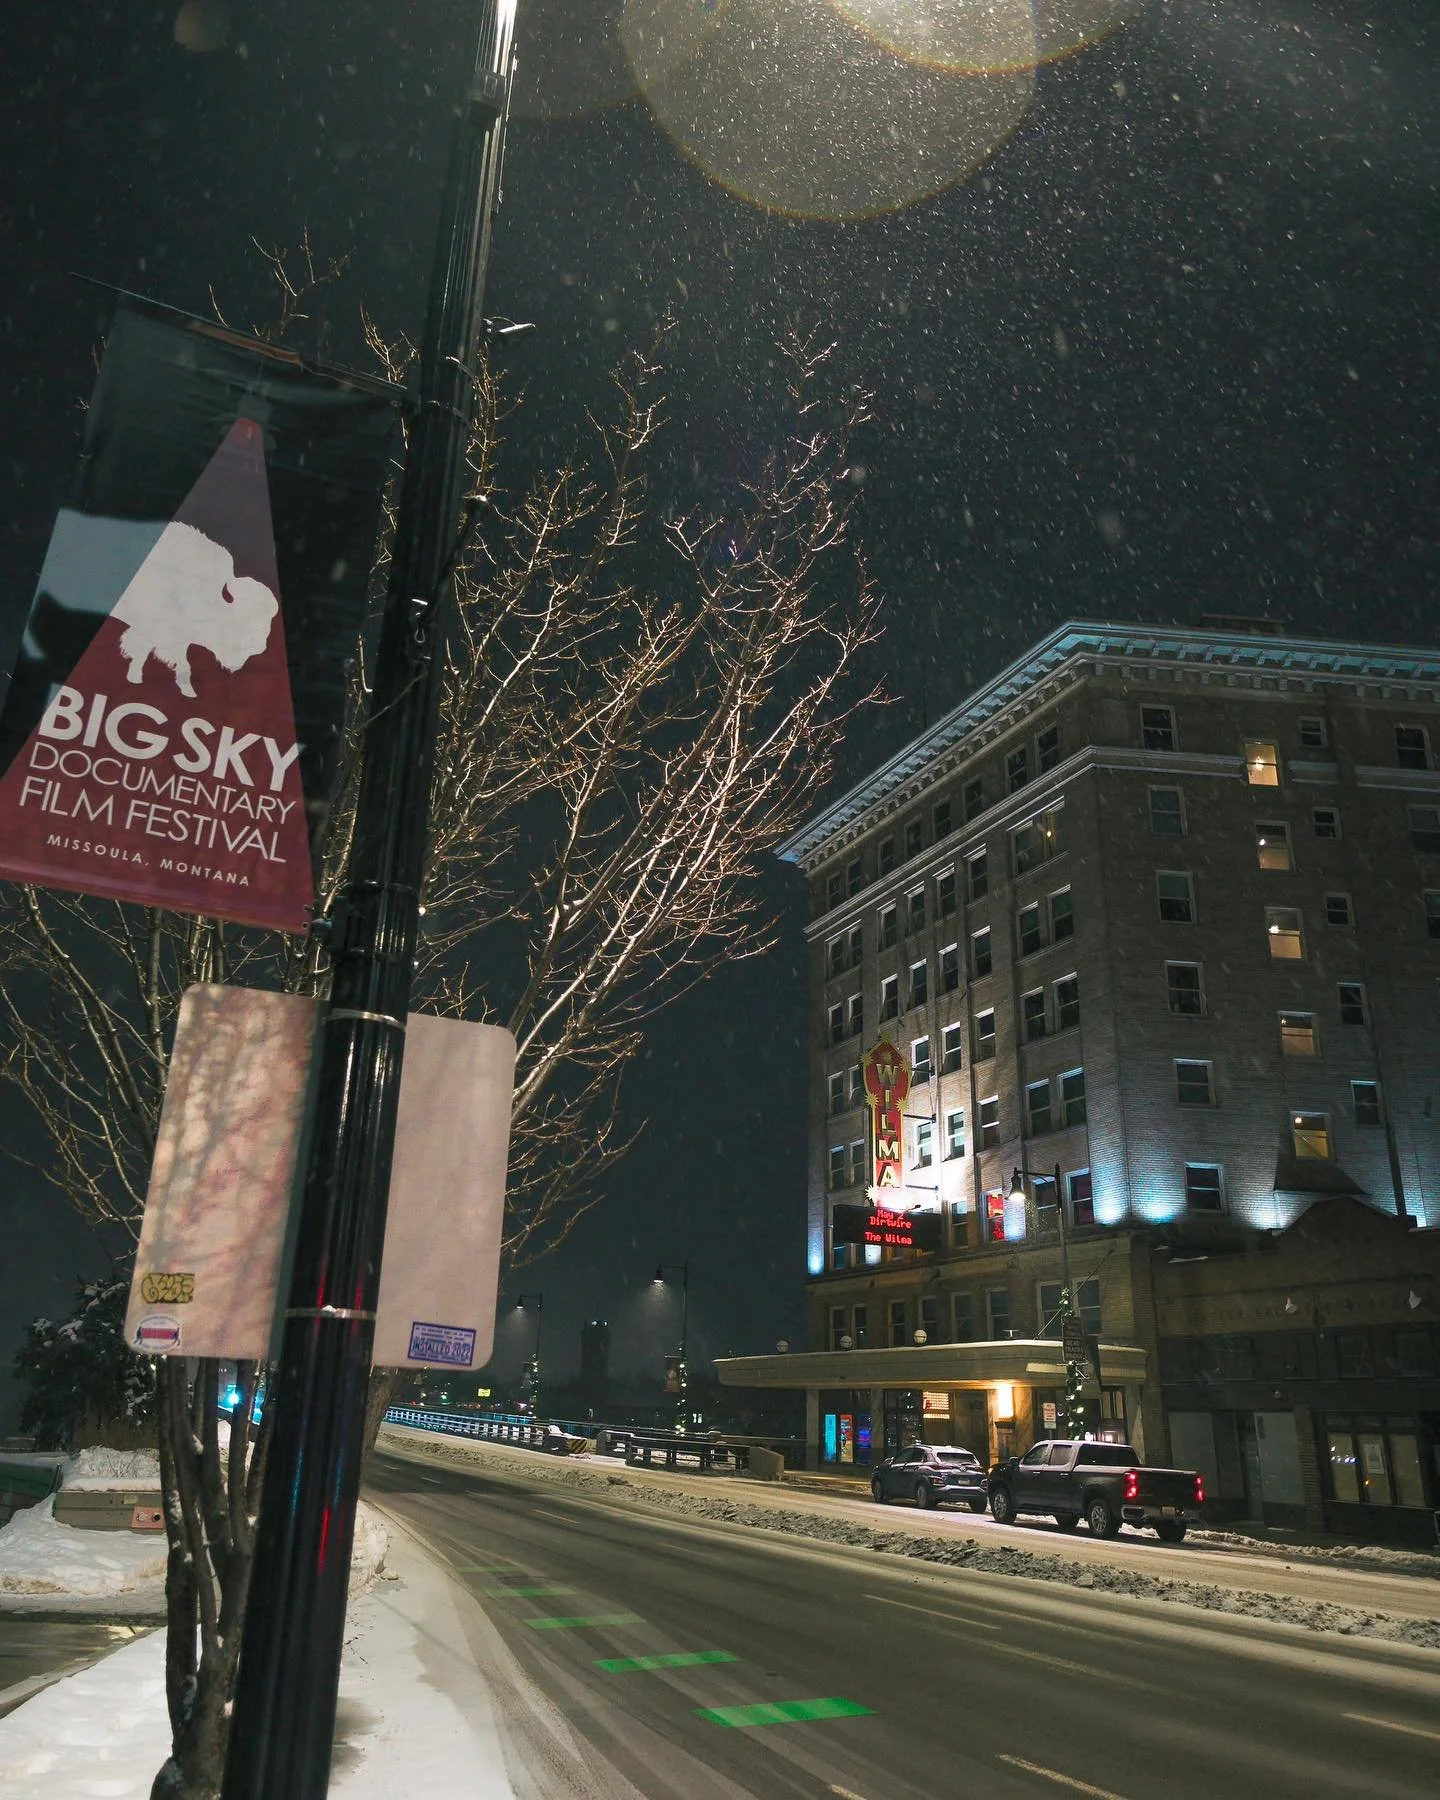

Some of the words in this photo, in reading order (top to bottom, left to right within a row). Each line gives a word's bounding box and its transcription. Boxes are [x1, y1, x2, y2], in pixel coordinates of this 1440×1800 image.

[39, 683, 169, 759] BIG
[173, 717, 305, 792] SKY
[29, 742, 296, 824] DOCUMENTARY
[19, 776, 115, 826] FILM
[125, 799, 287, 863] FESTIVAL
[47, 834, 150, 866] MISSOULA,
[160, 858, 249, 886] MONTANA
[876, 1063, 901, 1188] WILMA
[865, 1231, 881, 1241] The
[885, 1233, 912, 1244] Wilma
[870, 1216, 912, 1228] Dirtwire
[877, 1210, 894, 1219] May
